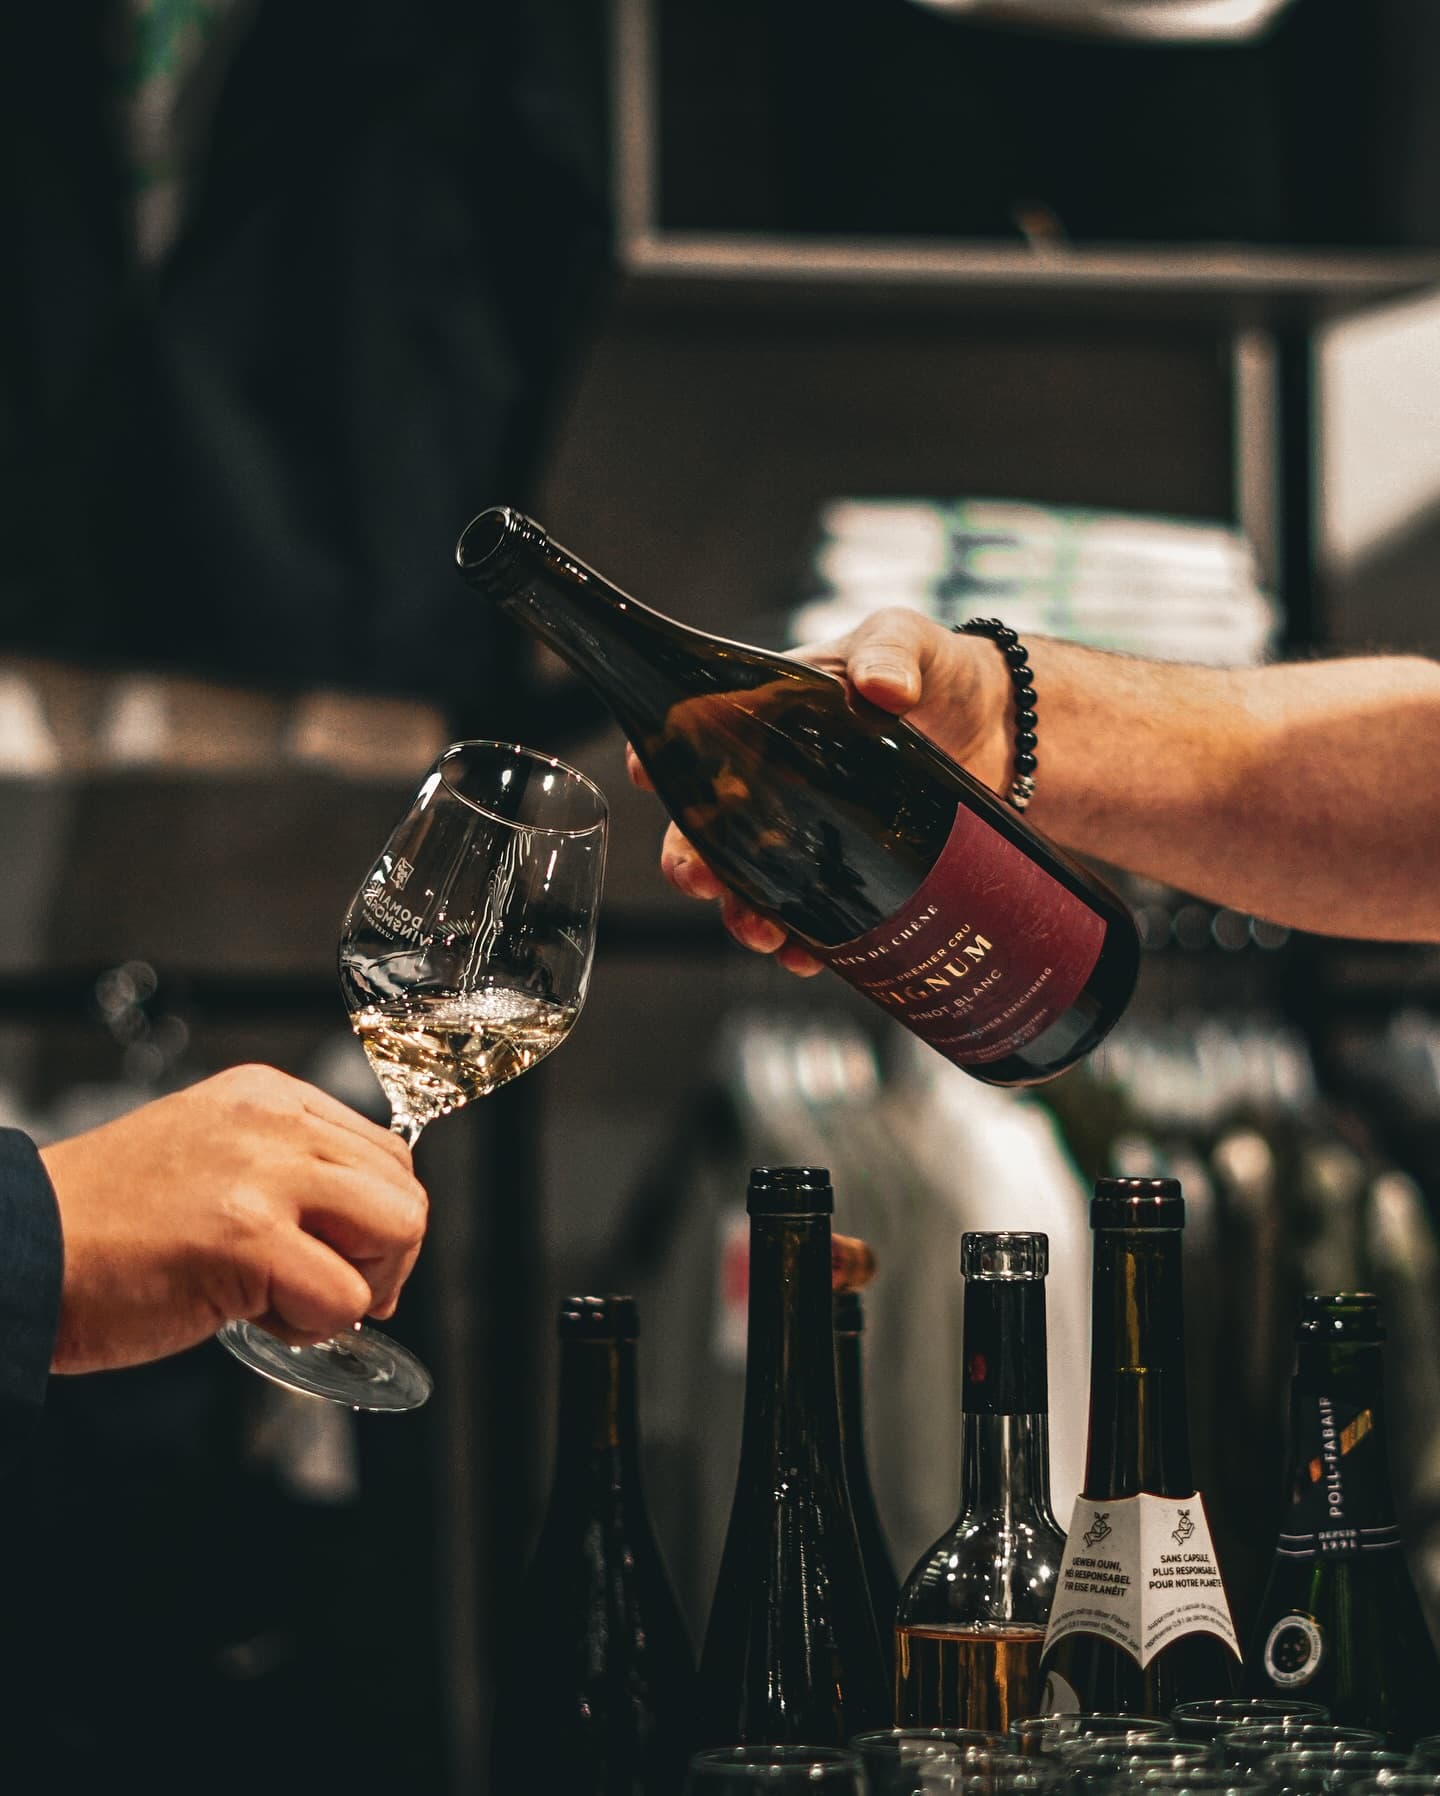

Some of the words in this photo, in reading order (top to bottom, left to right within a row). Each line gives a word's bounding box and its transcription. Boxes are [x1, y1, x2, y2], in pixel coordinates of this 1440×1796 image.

[867, 945, 889, 959] DE
[892, 904, 939, 946] CHÊNE
[896, 948, 947, 983] PREMIER
[948, 923, 972, 948] CRU
[871, 933, 993, 1006] VIGNUM
[908, 1005, 950, 1021] PINOT
[954, 967, 1002, 1008] BLANC
[1321, 1540, 1357, 1551] 1991
[1160, 1554, 1182, 1563] SANS
[1097, 1559, 1122, 1573] OUNI,
[1152, 1567, 1174, 1576] PLUS
[1176, 1566, 1217, 1575] RESPONSABLE
[1075, 1569, 1131, 1585] RESPONSABEL
[1149, 1579, 1174, 1590] POUR
[1175, 1578, 1198, 1588] NOTRE
[1090, 1583, 1128, 1597] PLANÉIT
